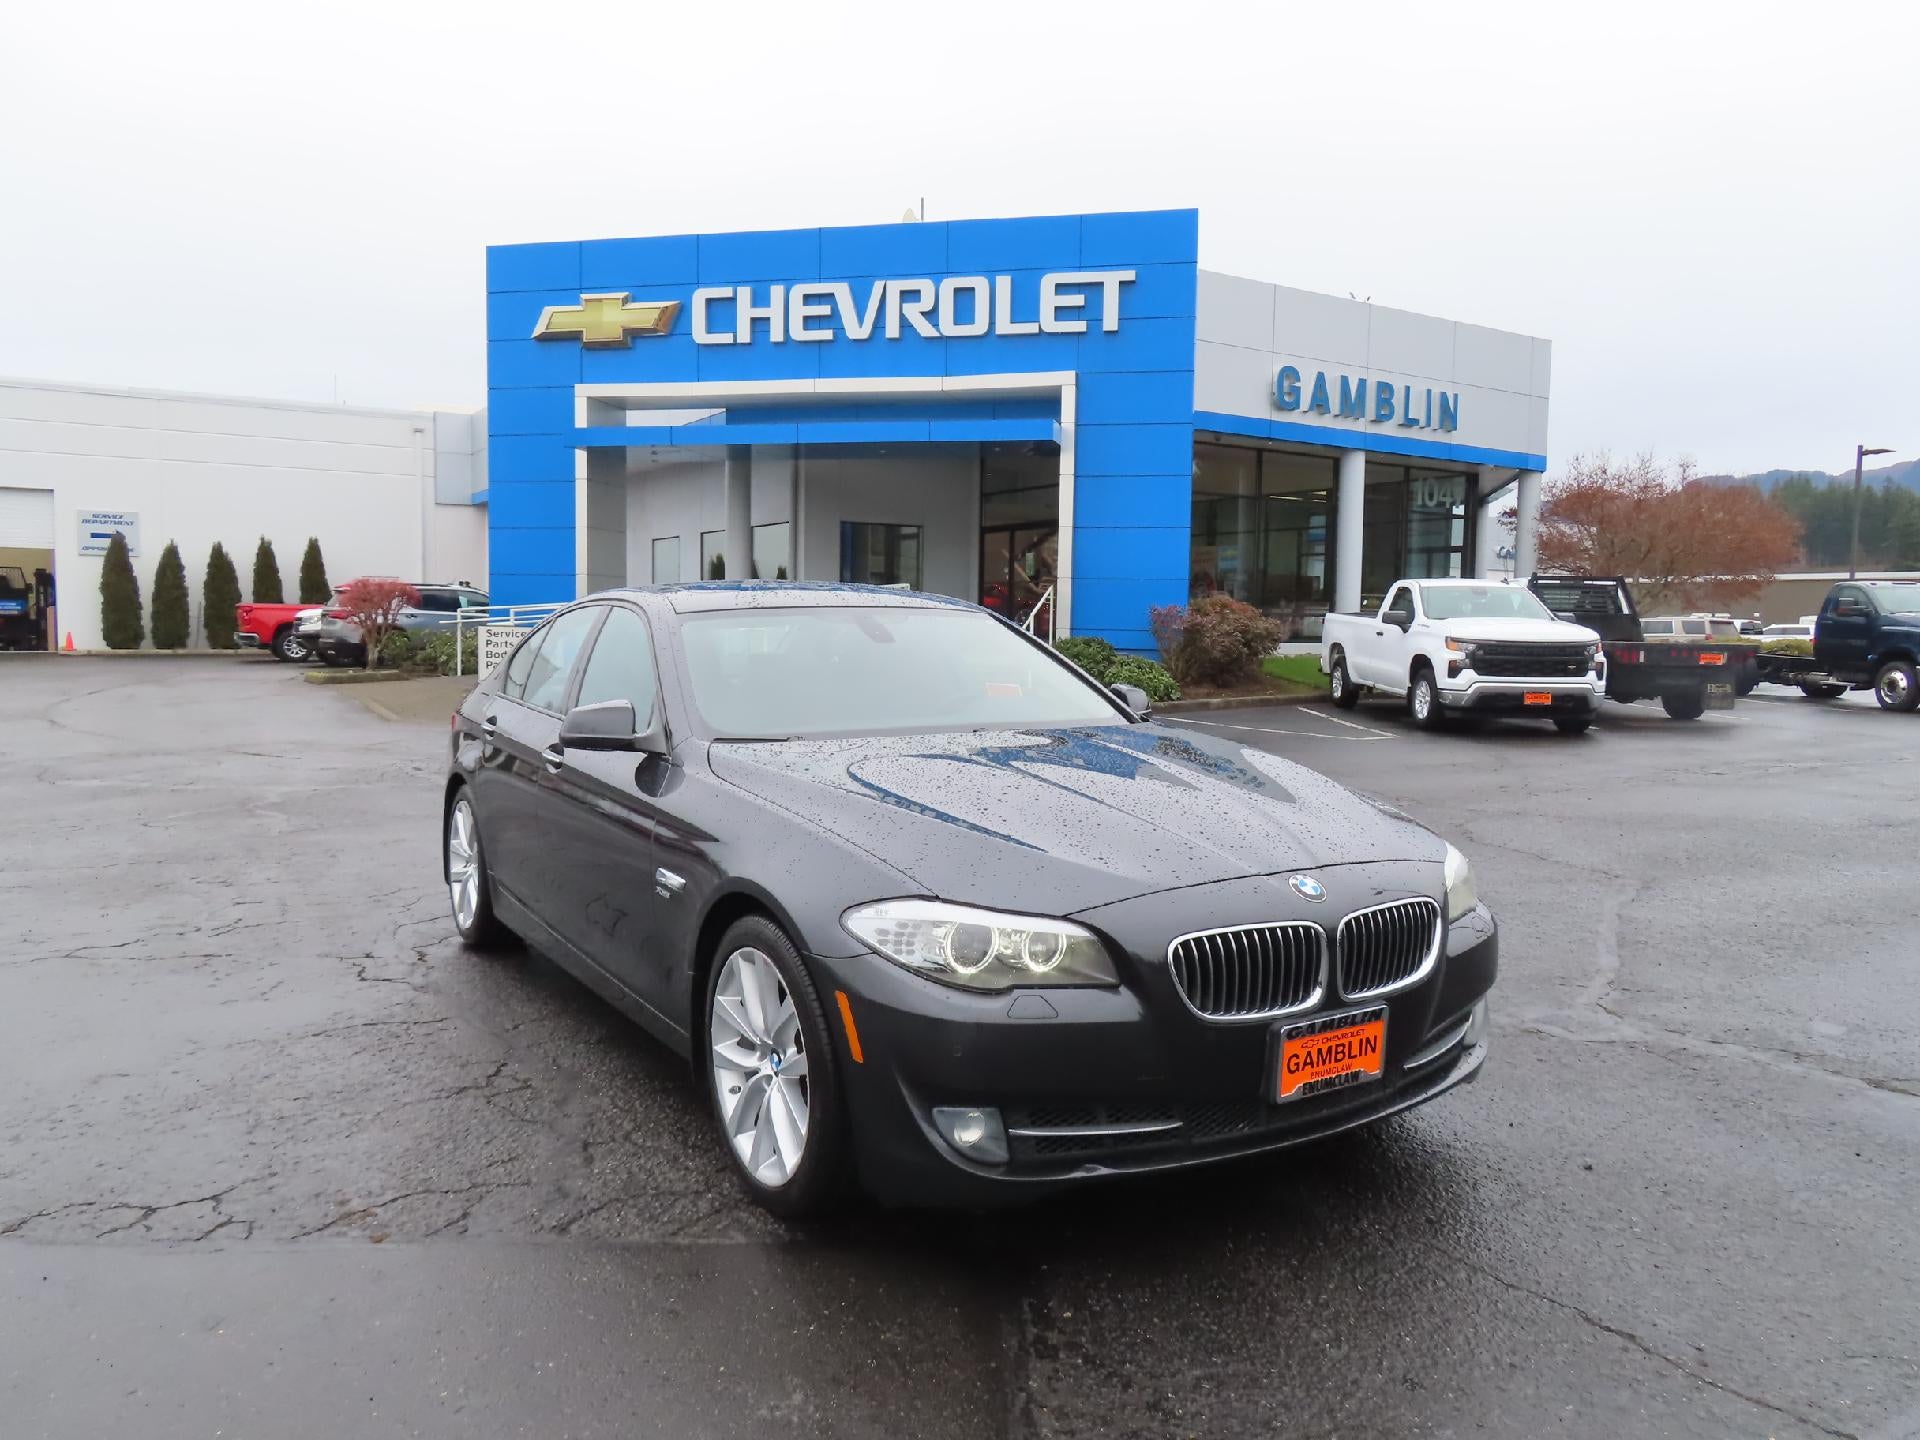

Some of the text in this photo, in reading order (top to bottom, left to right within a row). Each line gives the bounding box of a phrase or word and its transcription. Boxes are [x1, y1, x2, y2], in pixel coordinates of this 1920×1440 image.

[692, 270, 1136, 344] CHEVROLET
[1275, 365, 1459, 432] GAMBLIN
[486, 629, 527, 638] Service
[486, 640, 514, 648] Parts
[486, 650, 508, 659] Bod
[1321, 1029, 1366, 1044] CHEVROLET
[1287, 1035, 1378, 1074] GAMBLIN
[1311, 1063, 1353, 1079] ENUMCLAW
